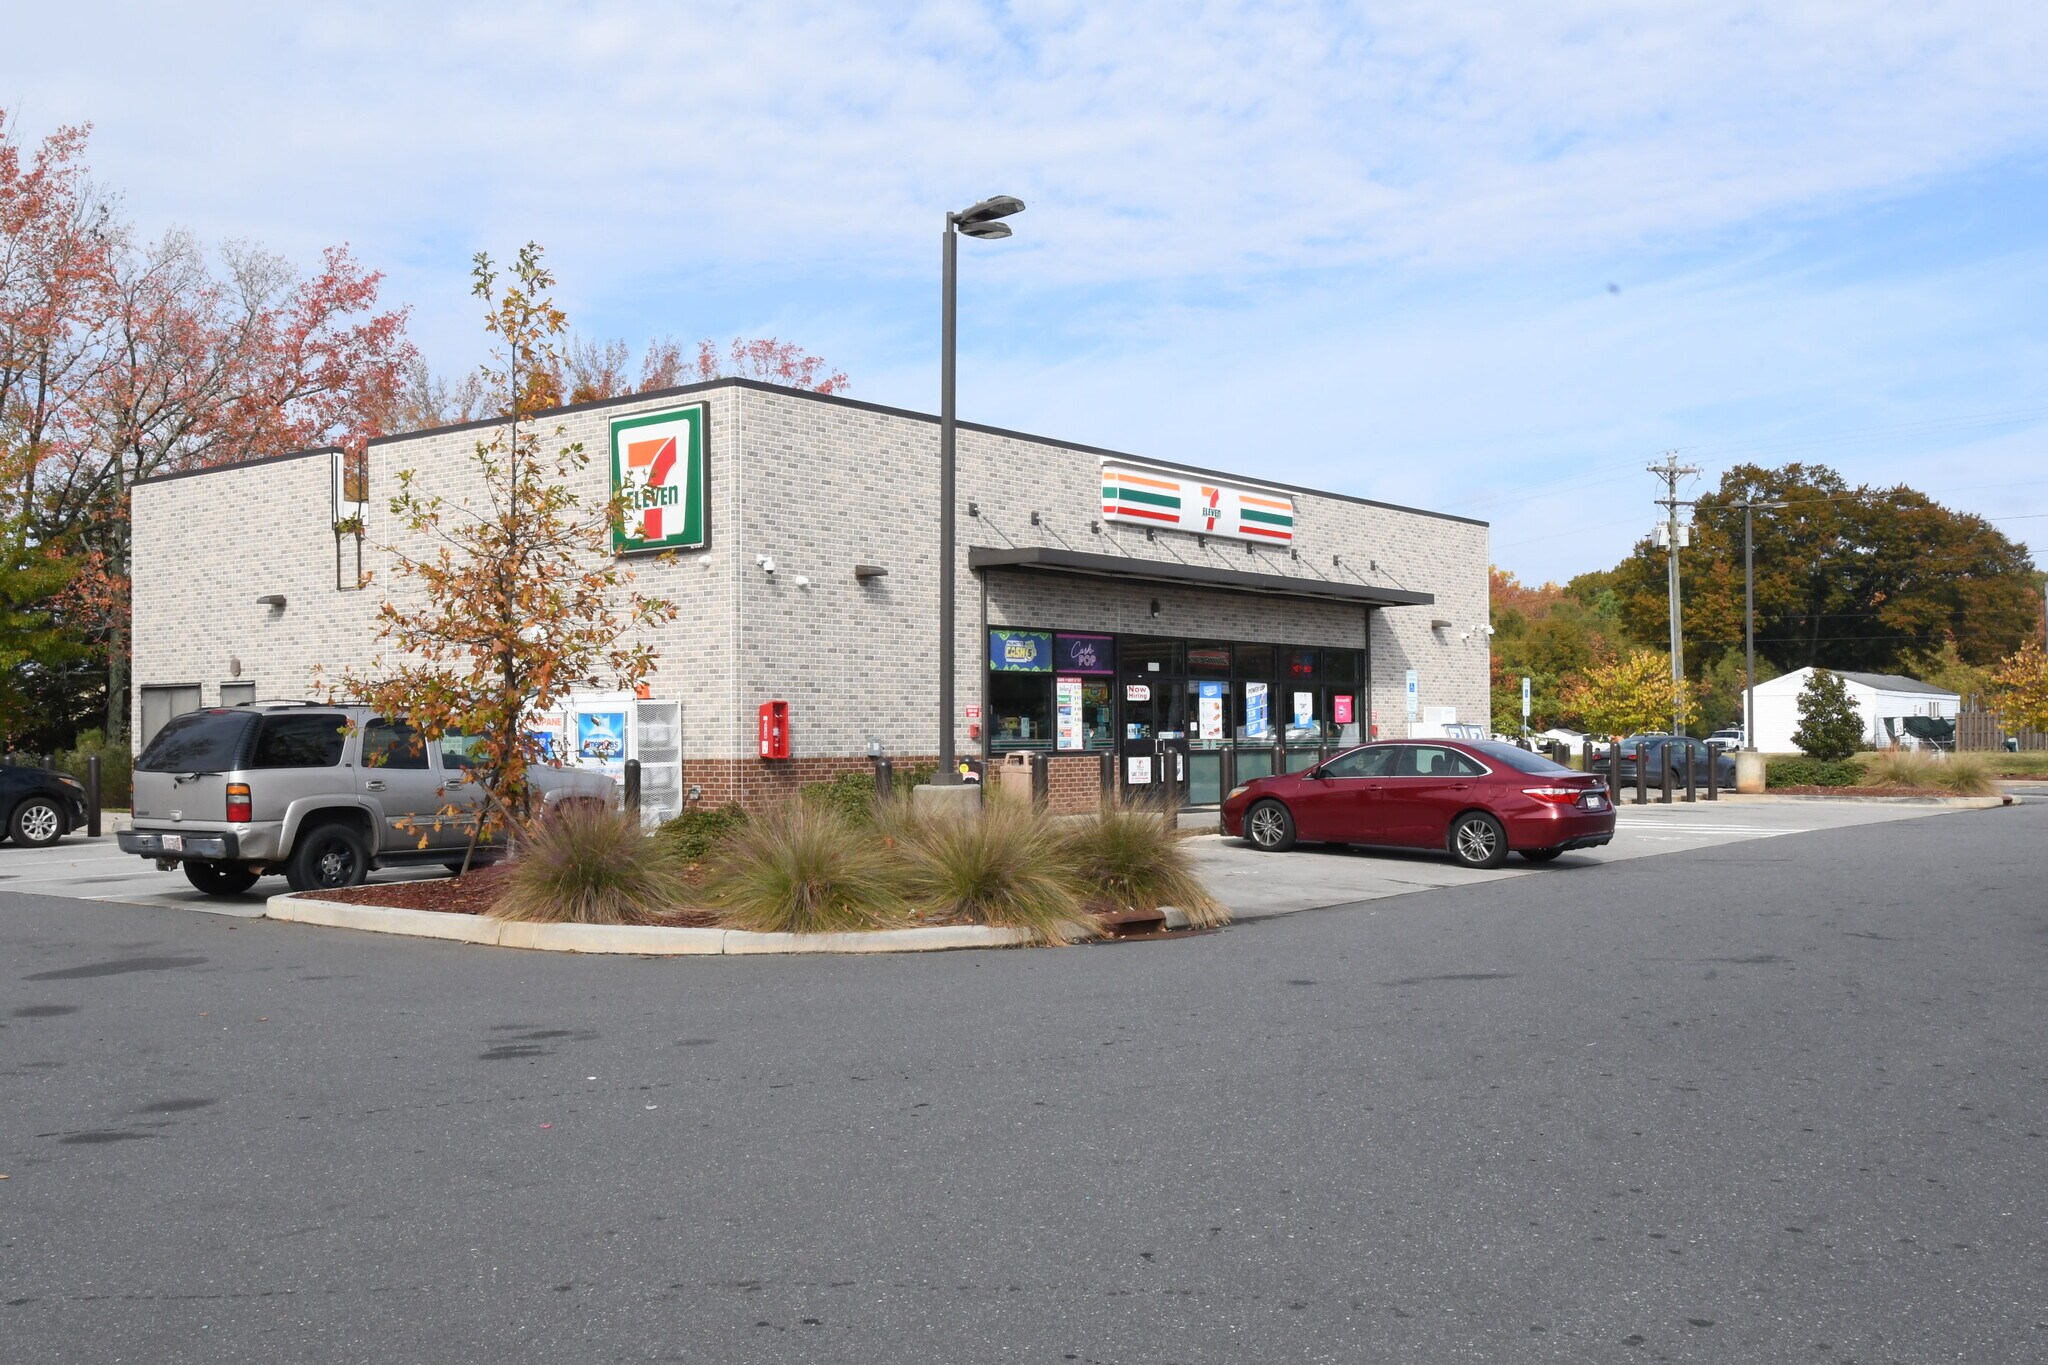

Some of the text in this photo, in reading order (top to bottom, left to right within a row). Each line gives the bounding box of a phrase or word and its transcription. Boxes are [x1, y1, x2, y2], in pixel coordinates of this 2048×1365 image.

[627, 435, 677, 540] 7
[1201, 486, 1219, 530] 7
[1006, 646, 1026, 659] CASH
[1070, 640, 1095, 659] Cash
[1078, 654, 1097, 667] POP
[1128, 685, 1147, 693] Now
[1247, 684, 1266, 694] POWER UP
